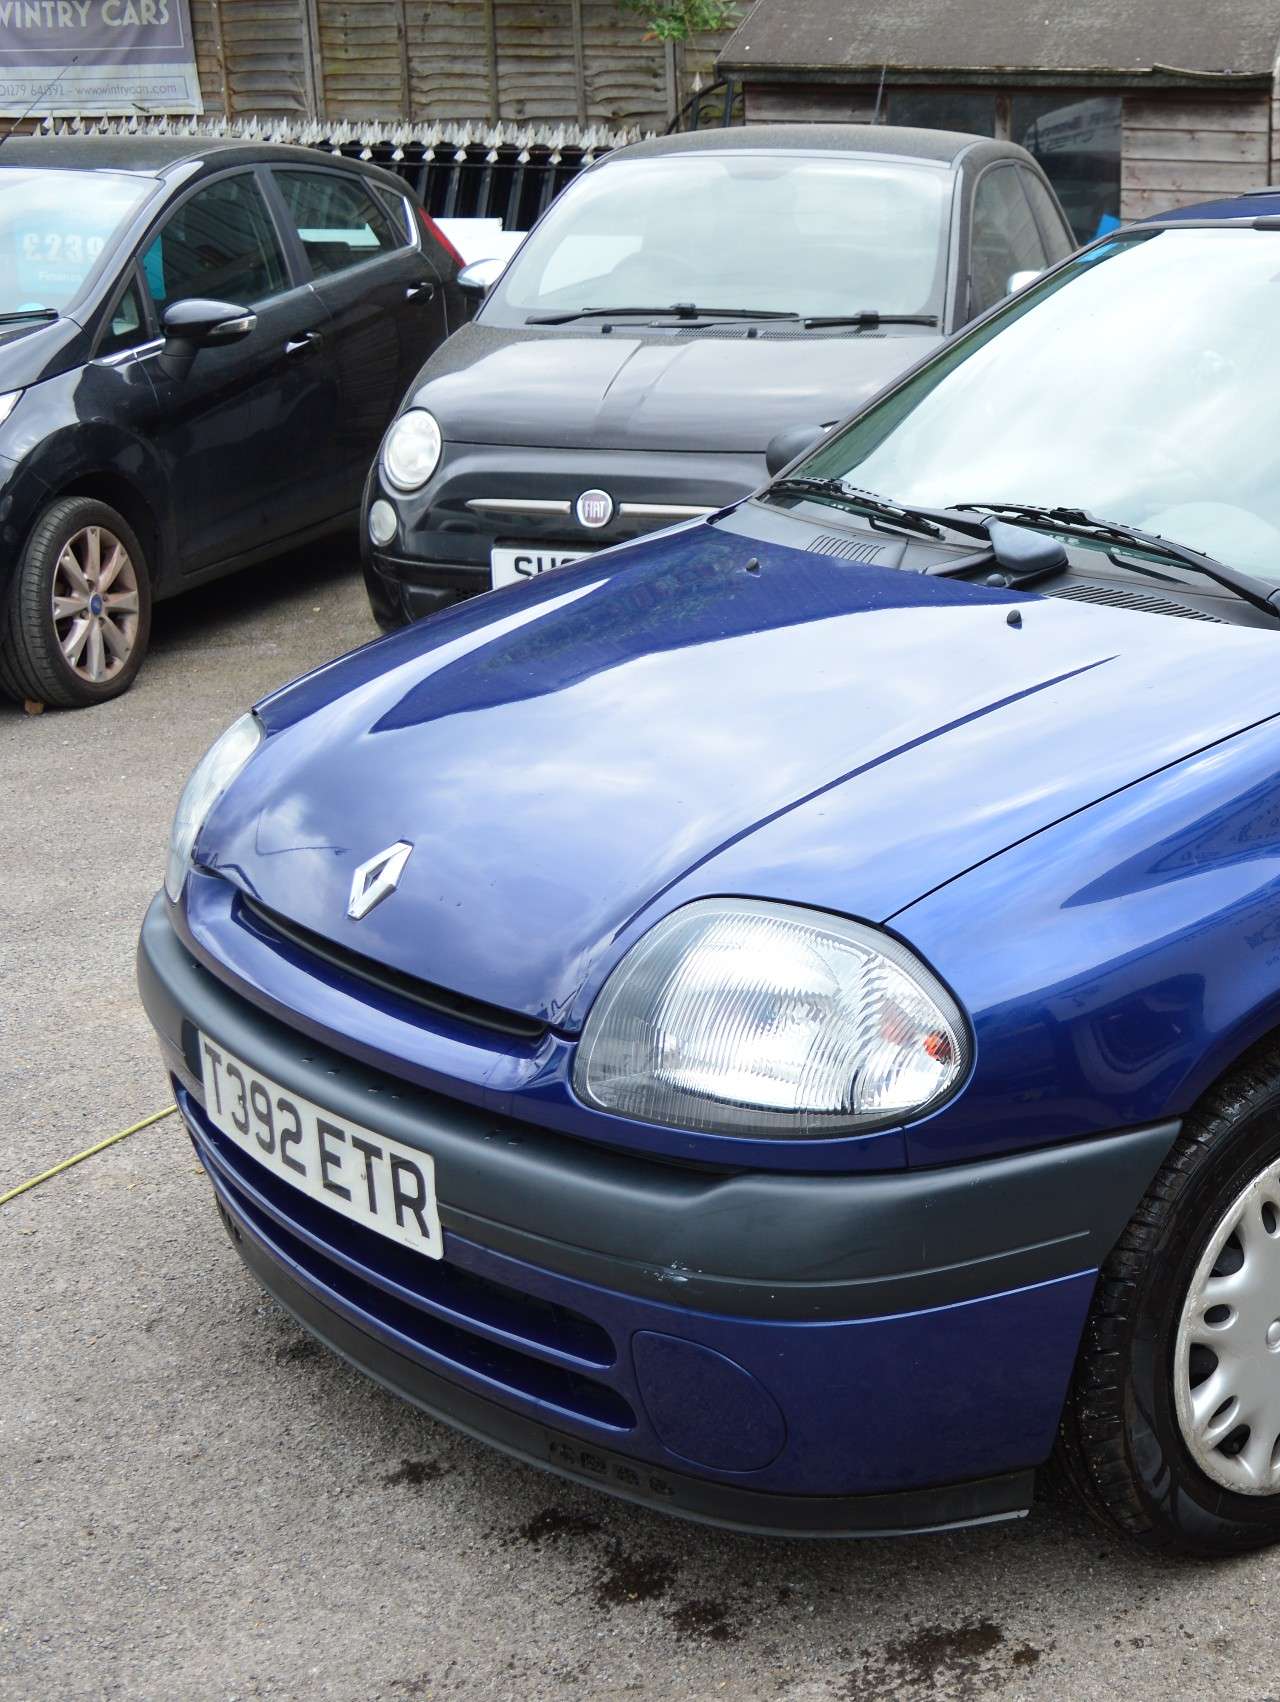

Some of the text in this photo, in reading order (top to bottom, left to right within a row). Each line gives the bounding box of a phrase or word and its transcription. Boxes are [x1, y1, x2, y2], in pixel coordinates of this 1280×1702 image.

[0, 0, 169, 28] WINTRY CARS
[584, 500, 606, 519] FIAT
[203, 1041, 430, 1240] T392 ETR
